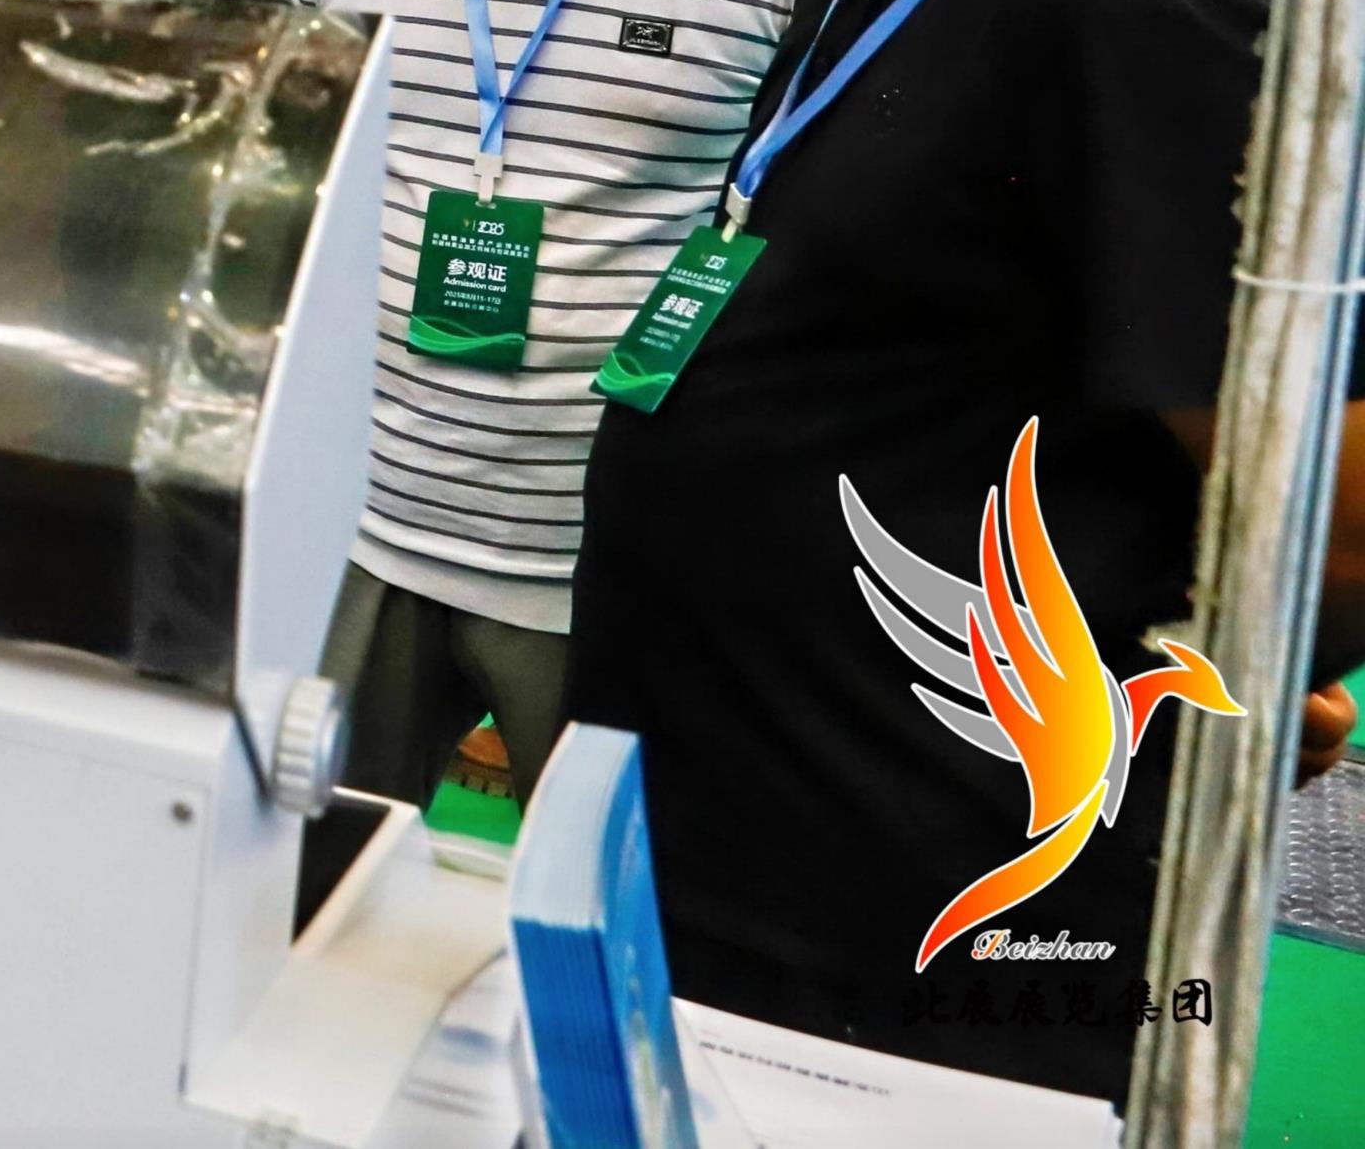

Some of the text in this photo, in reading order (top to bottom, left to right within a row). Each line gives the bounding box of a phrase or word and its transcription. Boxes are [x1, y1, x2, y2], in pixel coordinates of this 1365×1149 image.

[447, 258, 507, 282] 参观证
[443, 276, 507, 293] Admission card
